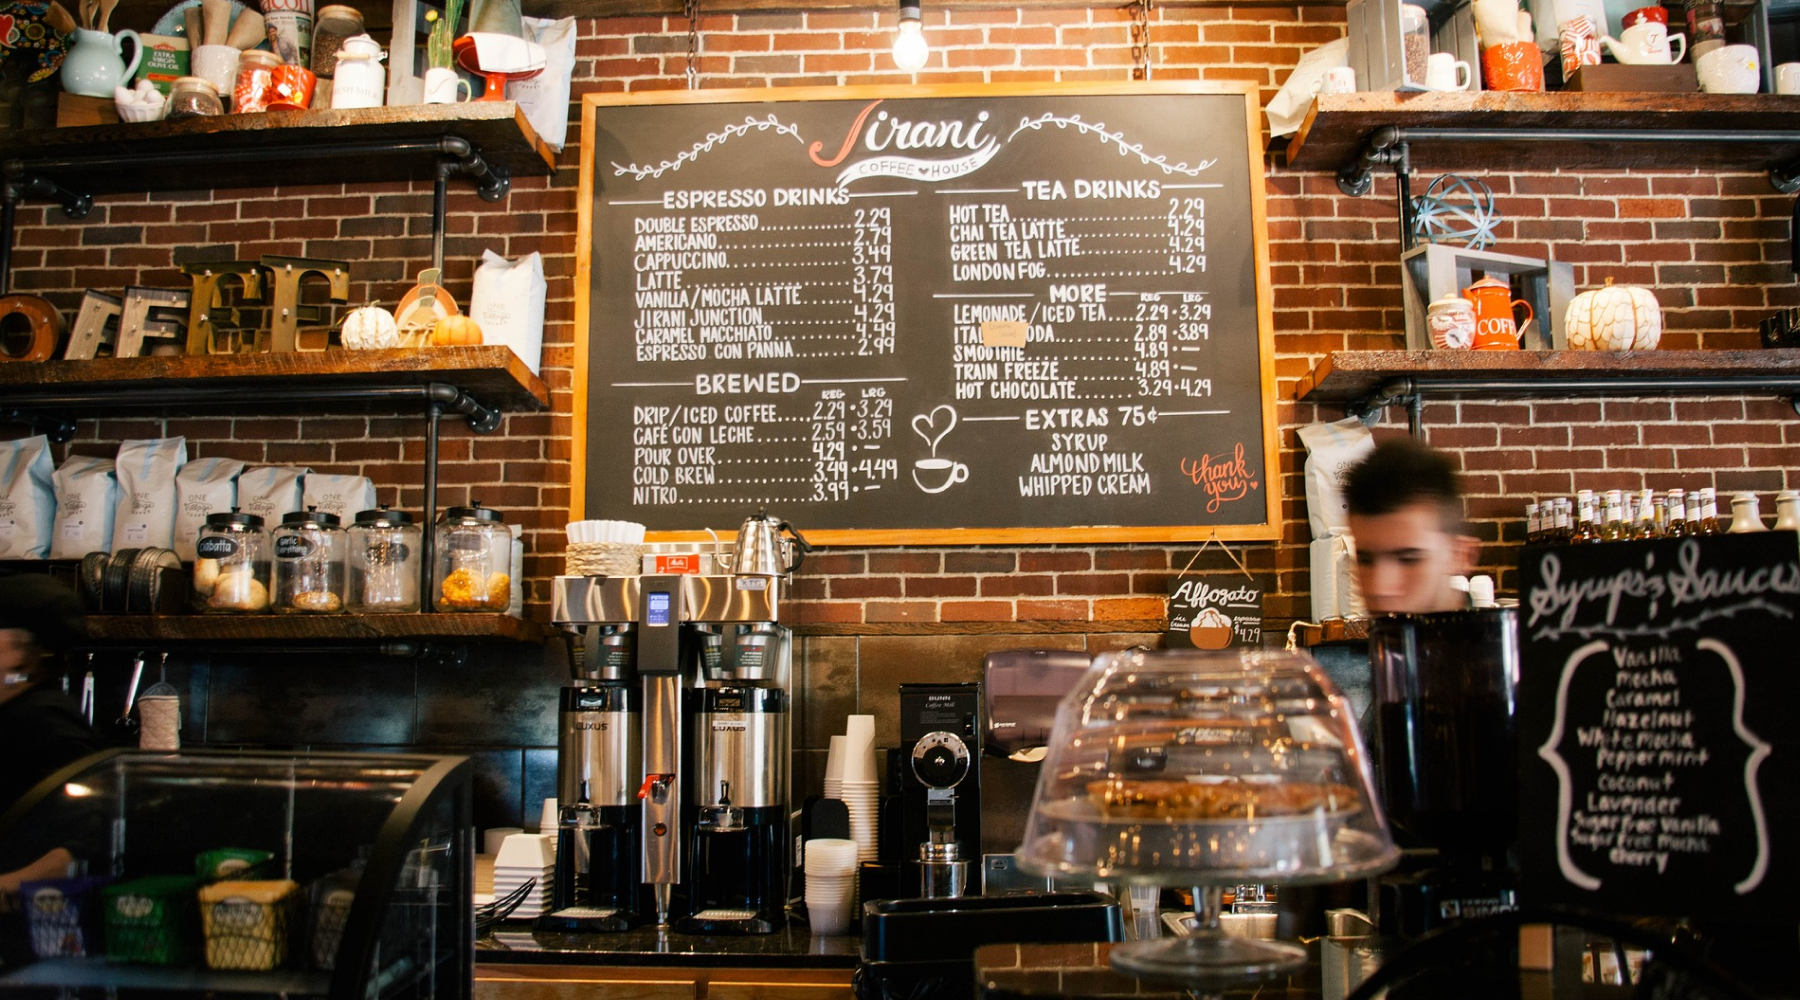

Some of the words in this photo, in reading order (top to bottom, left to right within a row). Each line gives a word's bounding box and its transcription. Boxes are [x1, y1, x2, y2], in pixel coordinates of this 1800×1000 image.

[153, 51, 175, 59] EXTRA
[809, 99, 990, 167] Jirani
[859, 161, 914, 175] COFFEE
[932, 158, 977, 177] HOUSE
[663, 189, 767, 208] ESPRESSO
[774, 189, 850, 206] DRINKS
[1023, 181, 1067, 200] TEA
[1075, 180, 1161, 198] DRINKS
[635, 217, 685, 234] DOUBLE
[692, 215, 758, 231] ESPRESSO
[854, 208, 891, 228] 2.29
[950, 205, 978, 224] HOT
[983, 205, 1010, 222] TEA
[1169, 199, 1204, 219] 2.29
[635, 233, 717, 251] AMERICANO
[854, 227, 891, 246] 2.79
[951, 225, 984, 242] CHAI
[990, 224, 1018, 240] TEA
[1022, 221, 1065, 239] LATTE
[1168, 219, 1205, 236] 4.29
[634, 253, 727, 271] CAPPUCCINO
[853, 246, 891, 264] 3.49
[951, 243, 998, 261] GREEN
[1005, 241, 1032, 259] TEA
[1038, 239, 1080, 256] LATTE
[1169, 238, 1205, 252] 4.29
[637, 271, 682, 290] LATTE
[854, 266, 892, 284] 3.79
[953, 264, 1015, 281] LONDON
[1019, 262, 1046, 280] FOG
[1169, 256, 1206, 273] 4.29
[756, 286, 801, 305] LATTE
[854, 284, 893, 303] 4.29
[1050, 284, 1106, 303] MORE
[1141, 293, 1161, 301] REG
[1183, 293, 1203, 302] LRG
[635, 308, 686, 328] JIRANI
[690, 307, 763, 326] JUNCTION
[854, 303, 895, 322] 4.29
[1079, 304, 1106, 321] TEA
[1136, 304, 1169, 321] 2.29
[1179, 304, 1211, 321] 3.29
[635, 328, 692, 344] CARAMEL
[701, 325, 772, 342] MACCHIATO
[856, 322, 895, 338] 4.49
[1024, 324, 1055, 343] ODA
[1134, 324, 1167, 341] 2.89
[1178, 324, 1208, 340] 3.89
[637, 345, 707, 361] ESPRESSO
[714, 344, 742, 359] CON
[748, 342, 793, 358] PANNA
[859, 338, 895, 356] 2.99
[953, 344, 1025, 362] SMOOTHIE
[1135, 342, 1168, 358] 4.89
[955, 363, 998, 380] TRAIN
[1005, 362, 1059, 380] FREEZE
[1135, 360, 1170, 377] 4.89
[696, 373, 800, 394] BREWED
[822, 390, 845, 399] REG
[862, 388, 886, 398] LRG
[956, 382, 984, 400] HOT
[991, 382, 1075, 399] CHOCOLATE
[1138, 379, 1172, 396] 3.29
[1180, 378, 1212, 396] 4.29
[634, 405, 718, 426] DRIP/ICED
[725, 405, 776, 422] COFFEE
[813, 402, 845, 419] 2.29
[858, 399, 893, 418] 3.29
[1026, 408, 1109, 429] EXTRAS
[1118, 406, 1158, 426] 75¢
[673, 427, 702, 444] CON
[710, 426, 754, 442] LECHE
[812, 421, 845, 441] 2.59
[858, 419, 891, 439] 3.59
[1052, 433, 1107, 452] SYRUP
[635, 448, 671, 465] POUR
[678, 447, 715, 464] OVER
[813, 442, 845, 460] 4.29
[1031, 453, 1100, 473] ALMOND
[1104, 453, 1144, 472] MILK
[1181, 442, 1255, 485] thank
[634, 467, 668, 485] COLD
[676, 466, 715, 484] BREW
[813, 461, 848, 482] 3.49
[859, 459, 898, 480] 4.49
[634, 487, 677, 505] NITRO
[813, 481, 849, 501] 3.99
[1019, 476, 1091, 497] WHIPPED
[1098, 474, 1151, 495] CREAM
[1203, 479, 1247, 513] you
[1171, 581, 1259, 608] Affogato
[1613, 646, 1682, 669] Vanilla
[925, 701, 943, 709] Coffee
[1606, 689, 1680, 708] Caramel
[1604, 709, 1693, 728] Hazelnut
[1588, 793, 1680, 814] Lavender
[1574, 810, 1619, 829] Sugar
[1661, 815, 1720, 834] Vanilla
